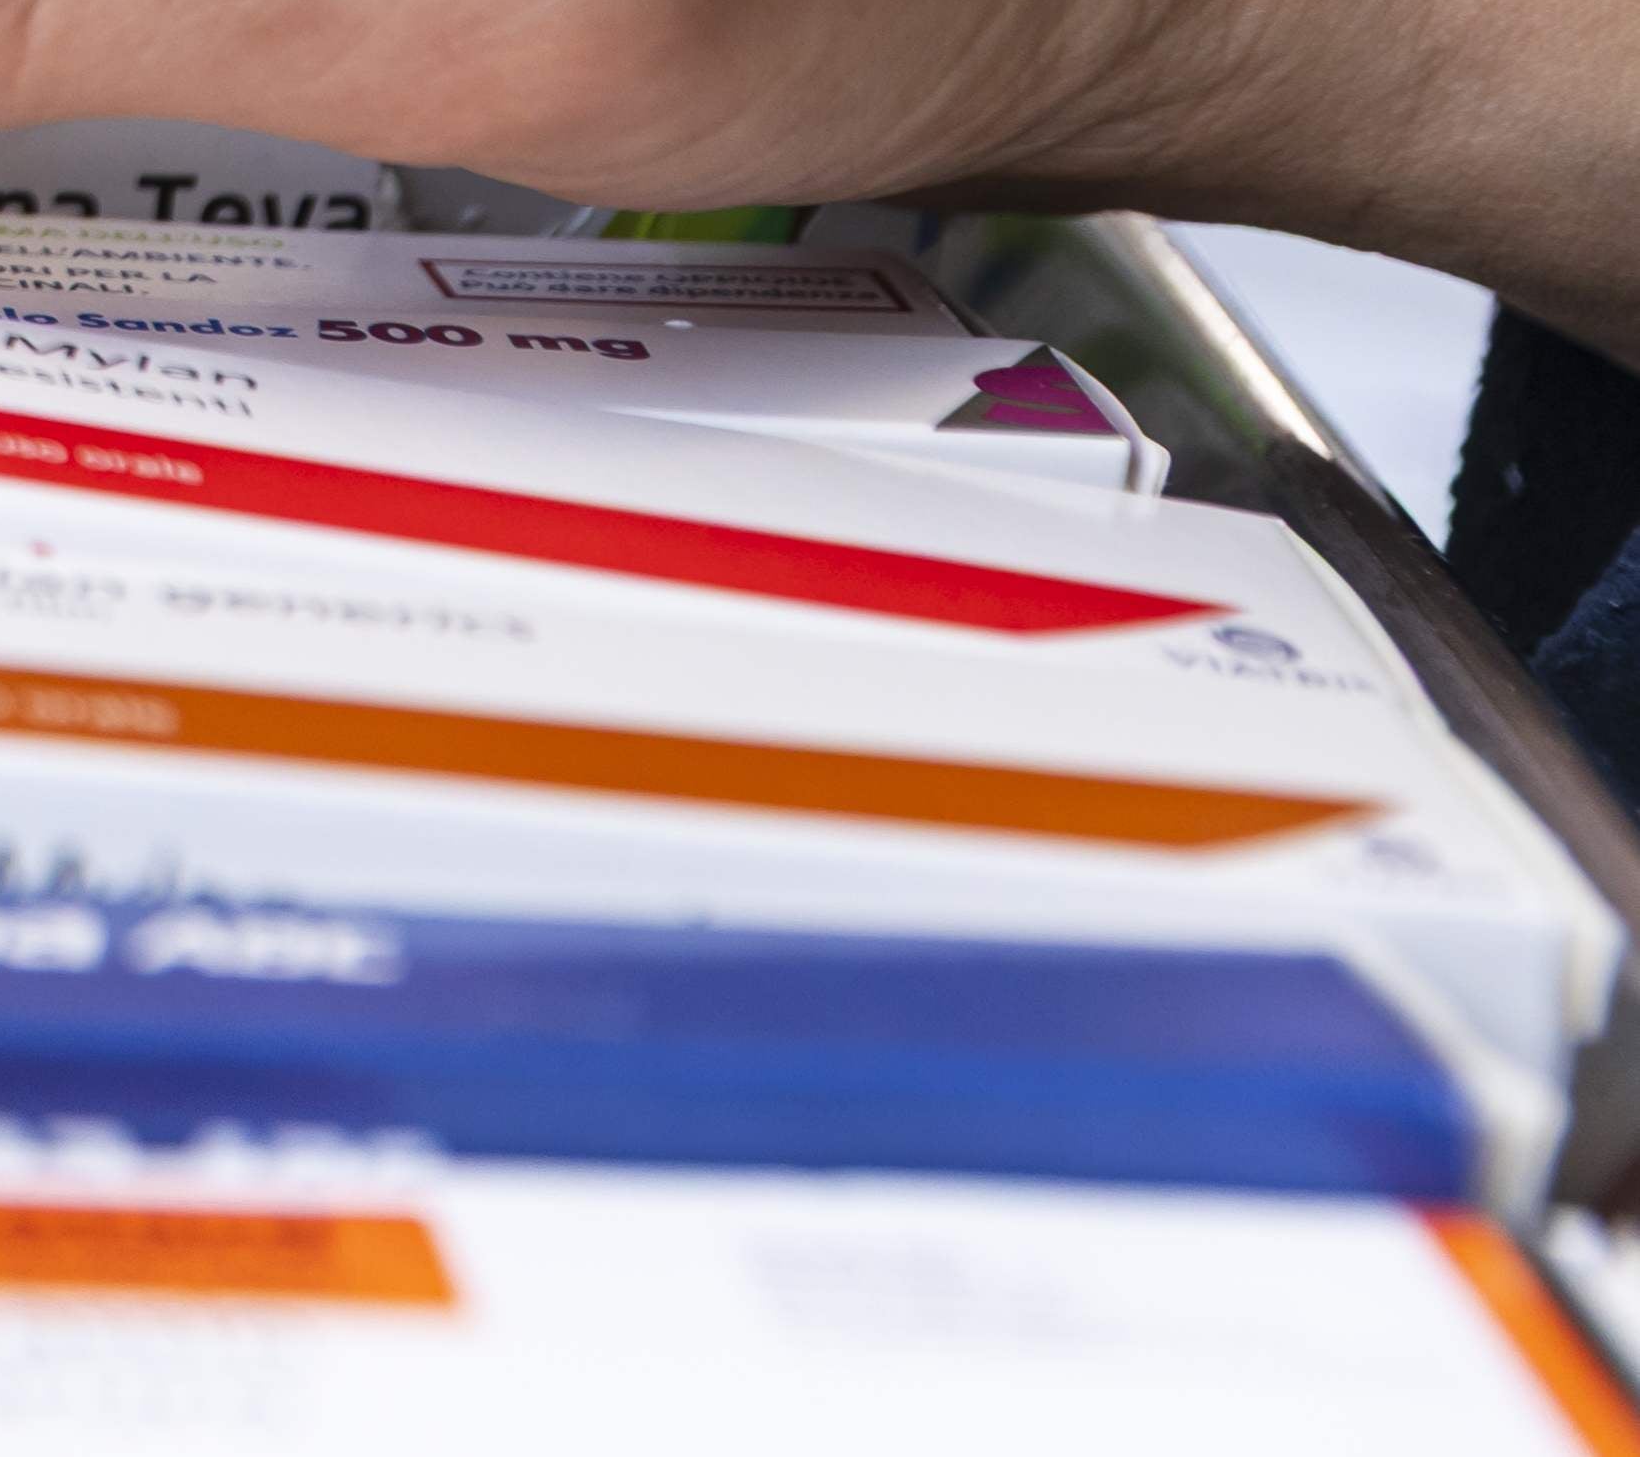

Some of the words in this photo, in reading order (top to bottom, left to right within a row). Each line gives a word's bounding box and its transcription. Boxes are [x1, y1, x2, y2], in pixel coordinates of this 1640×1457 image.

[137, 174, 374, 232] Teva
[65, 267, 152, 282] PER
[162, 271, 218, 285] LA
[5, 333, 259, 391] Mylan
[78, 311, 298, 339] Sandoz
[317, 319, 484, 348] 500
[509, 333, 651, 361] mg
